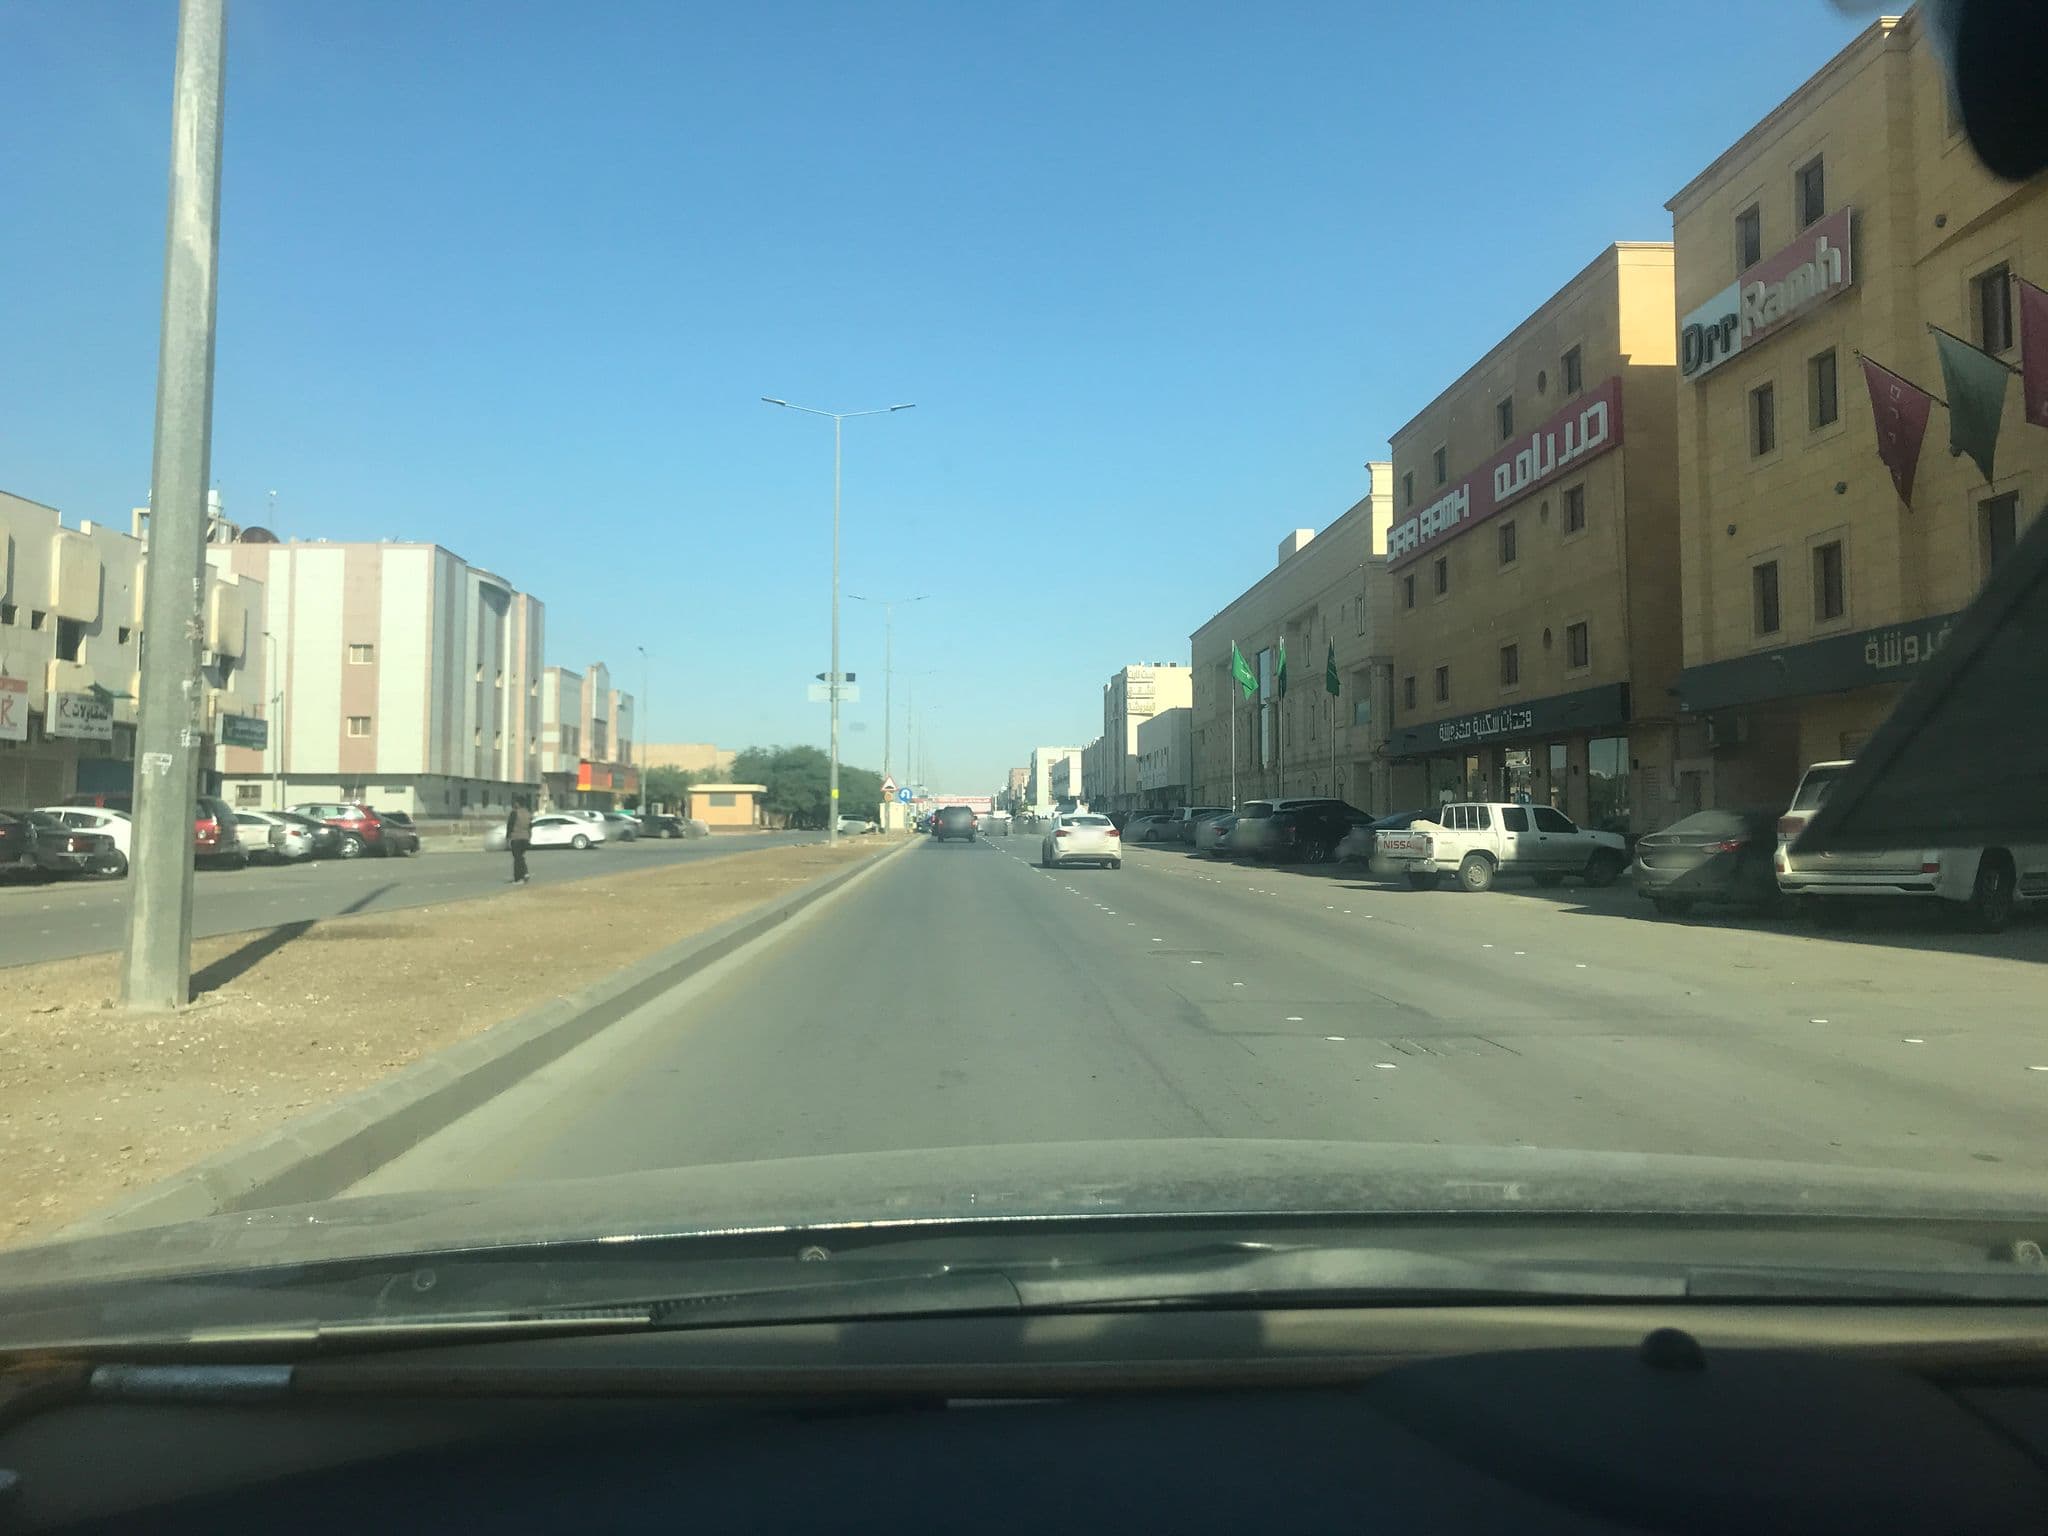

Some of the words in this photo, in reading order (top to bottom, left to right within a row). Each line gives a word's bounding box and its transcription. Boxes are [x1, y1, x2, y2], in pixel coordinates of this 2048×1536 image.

[1682, 313, 1738, 376] Drr
[1743, 236, 1842, 337] Ramh
[1865, 621, 1952, 669] فروشة
[1440, 719, 1472, 742] مفروشة
[1473, 713, 1500, 740] سكنية
[1501, 707, 1533, 732] وحدات
[1383, 840, 1419, 850] NISSA
